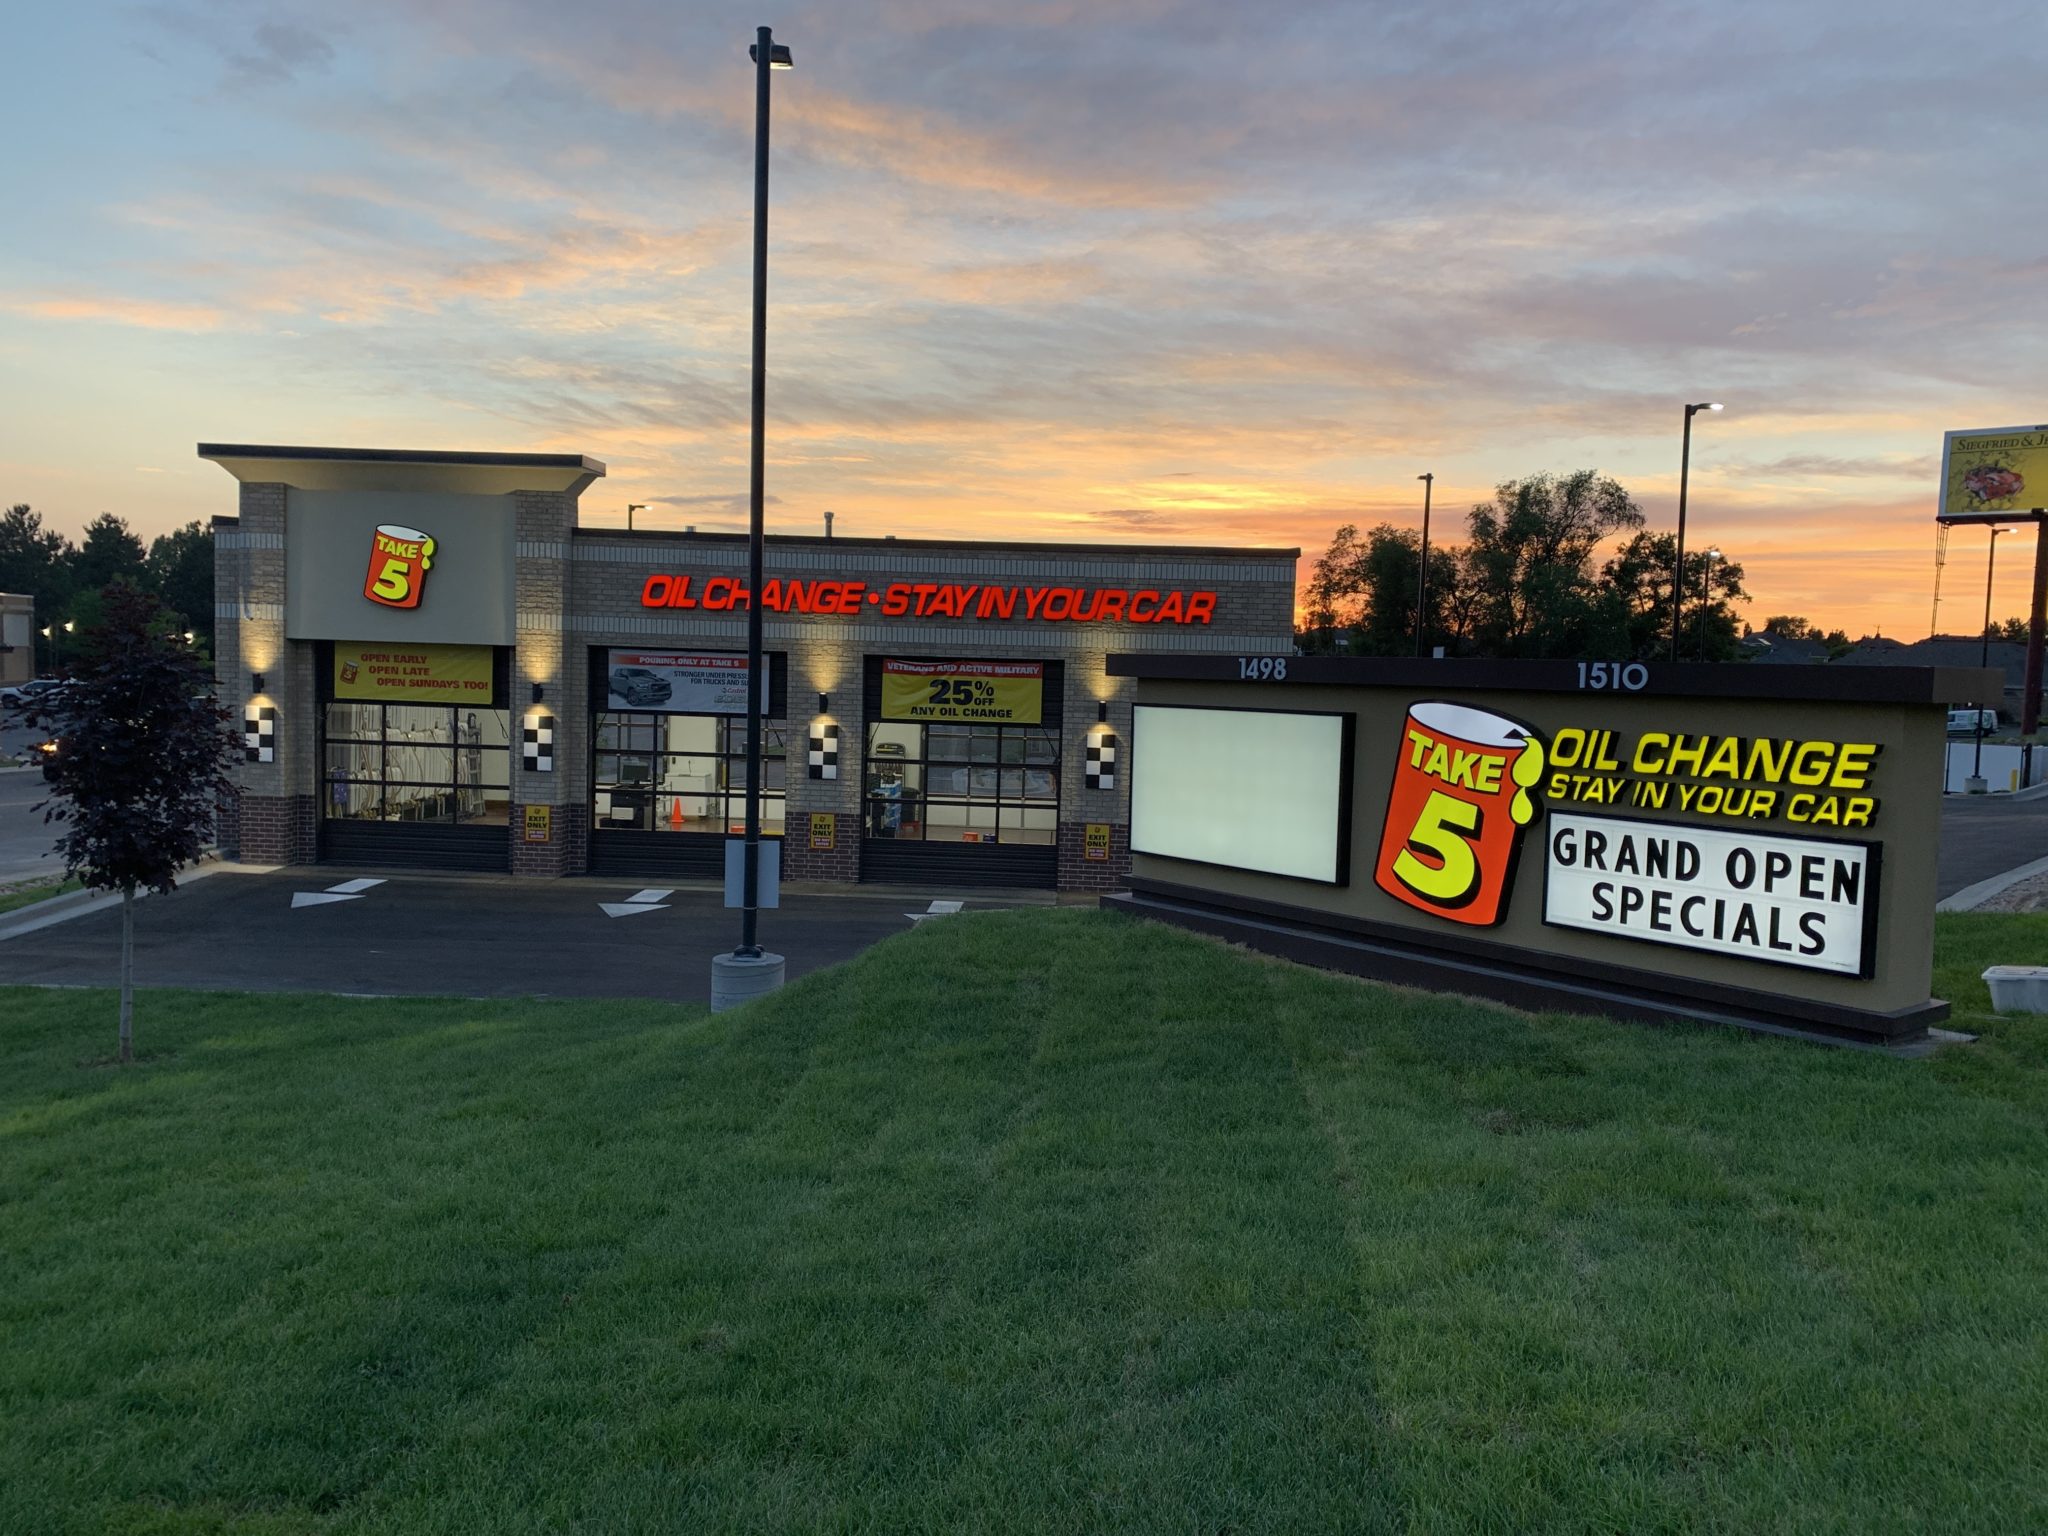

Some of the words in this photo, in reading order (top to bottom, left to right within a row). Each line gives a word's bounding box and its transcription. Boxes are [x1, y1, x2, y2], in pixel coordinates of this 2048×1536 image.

[1958, 438, 2019, 450] SIEGFRIED
[2021, 435, 2033, 446] &
[377, 536, 419, 558] TAKE
[372, 559, 410, 600] 5
[641, 575, 697, 608] OIL
[702, 577, 866, 614] CHANGE
[882, 584, 978, 617] STAY
[976, 587, 1018, 619] IN
[1025, 588, 1129, 622] YOUR
[1128, 591, 1217, 625] CAR
[361, 654, 390, 663] OPEN
[393, 654, 427, 664] EARLY
[639, 656, 676, 665] POURING
[677, 658, 698, 666] ONLY
[700, 658, 710, 667] AT
[712, 659, 732, 668] TAKE
[887, 662, 935, 672] VETERANS
[936, 664, 957, 672] AND
[959, 665, 993, 673] ACTIVE
[994, 666, 1040, 675] MILITARY
[1239, 657, 1287, 680] 1498
[368, 666, 398, 675] OPEN
[403, 666, 430, 676] LATE
[703, 678, 726, 686] TRUCKS
[705, 671, 726, 679] UNDER
[1578, 662, 1649, 690] 1510
[377, 677, 406, 687] OPEN
[409, 679, 460, 689] SUNDAYS
[463, 681, 488, 690] TOO!
[910, 706, 936, 716] ANY
[939, 707, 959, 717] OIL
[963, 708, 1012, 718] CHANGE
[974, 698, 994, 706] OFF
[1408, 729, 1506, 793] TAKE
[1548, 728, 1622, 772] OIL
[1632, 733, 1880, 790] CHANGE
[1547, 773, 1626, 804] STAY
[1632, 780, 1670, 809] IN
[1679, 784, 1777, 818] YOUR
[1786, 793, 1877, 827] CAR
[1392, 790, 1482, 902] 5
[1552, 827, 1701, 882] GRAND
[1725, 847, 1862, 906] OPEN
[1591, 881, 1827, 956] SPECIALS
